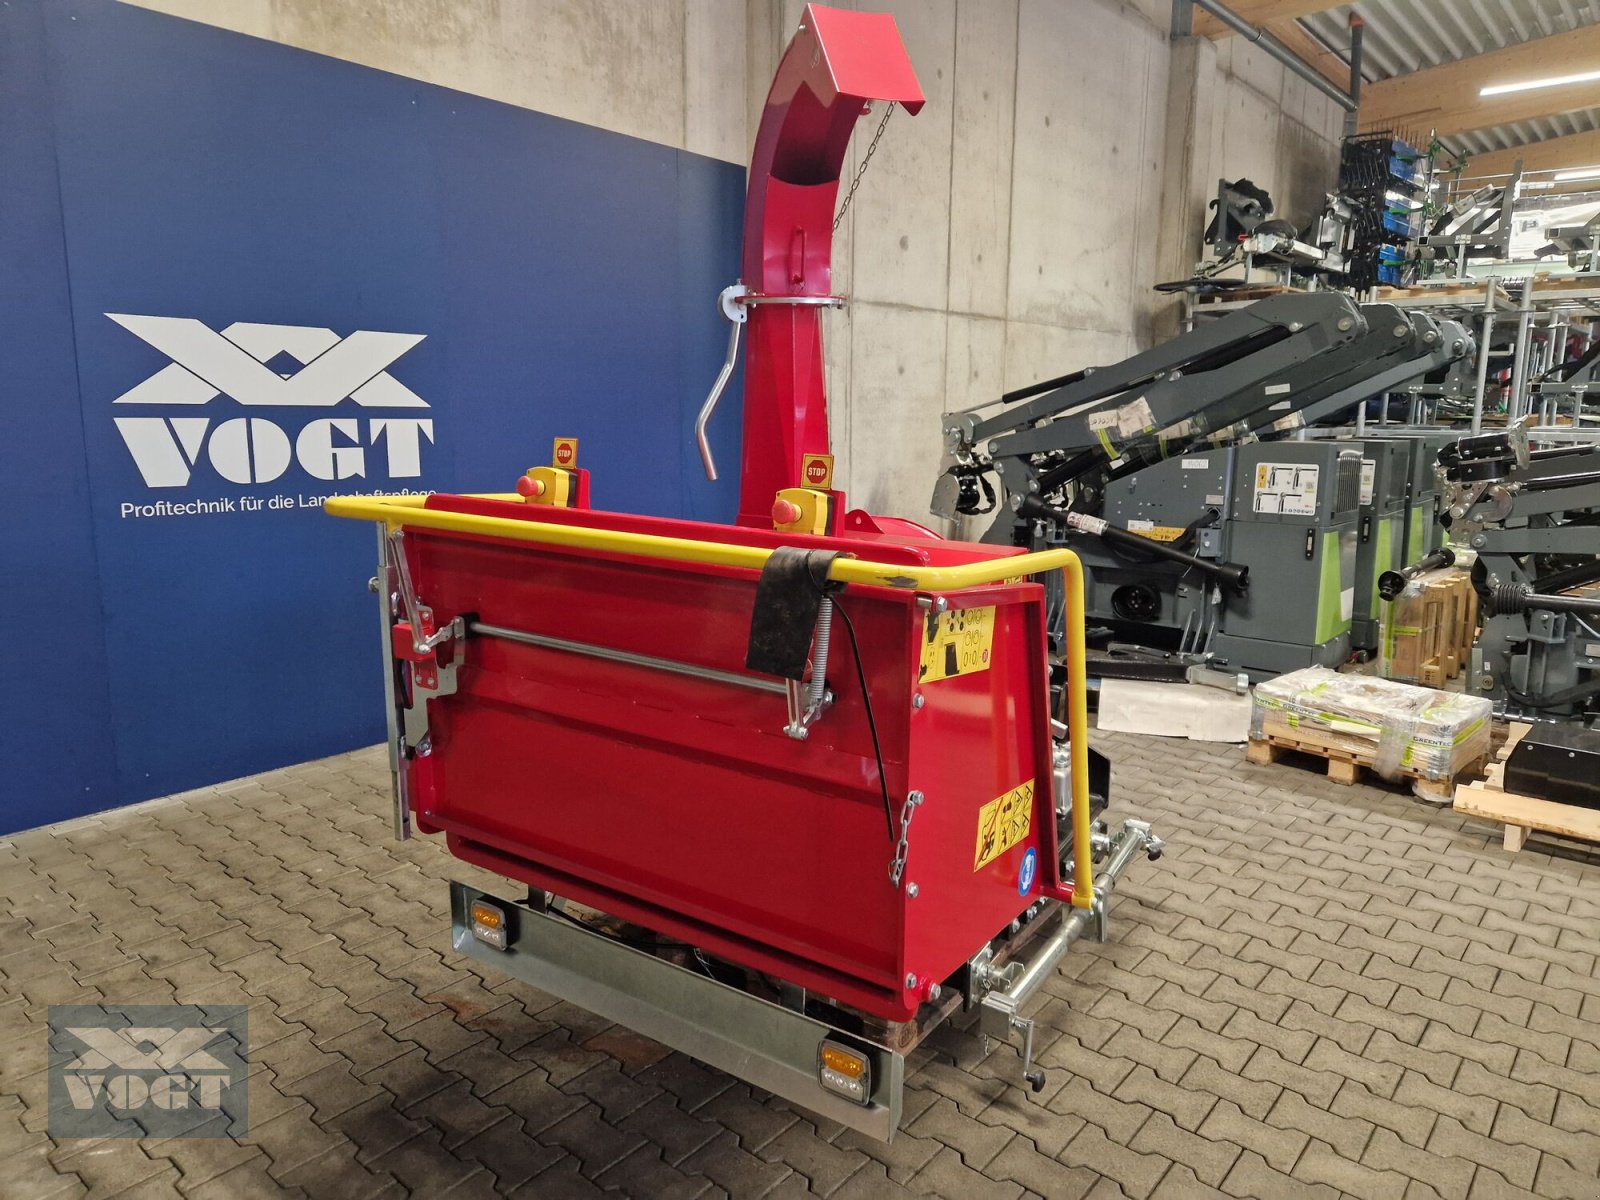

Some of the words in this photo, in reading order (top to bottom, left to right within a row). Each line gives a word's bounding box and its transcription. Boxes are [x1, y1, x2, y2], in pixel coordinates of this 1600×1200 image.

[113, 417, 434, 488] VOGT
[558, 449, 571, 458] STOP
[807, 467, 826, 477] STOP
[120, 498, 235, 519] Profitechnik
[239, 496, 264, 511] für
[268, 494, 294, 510] die
